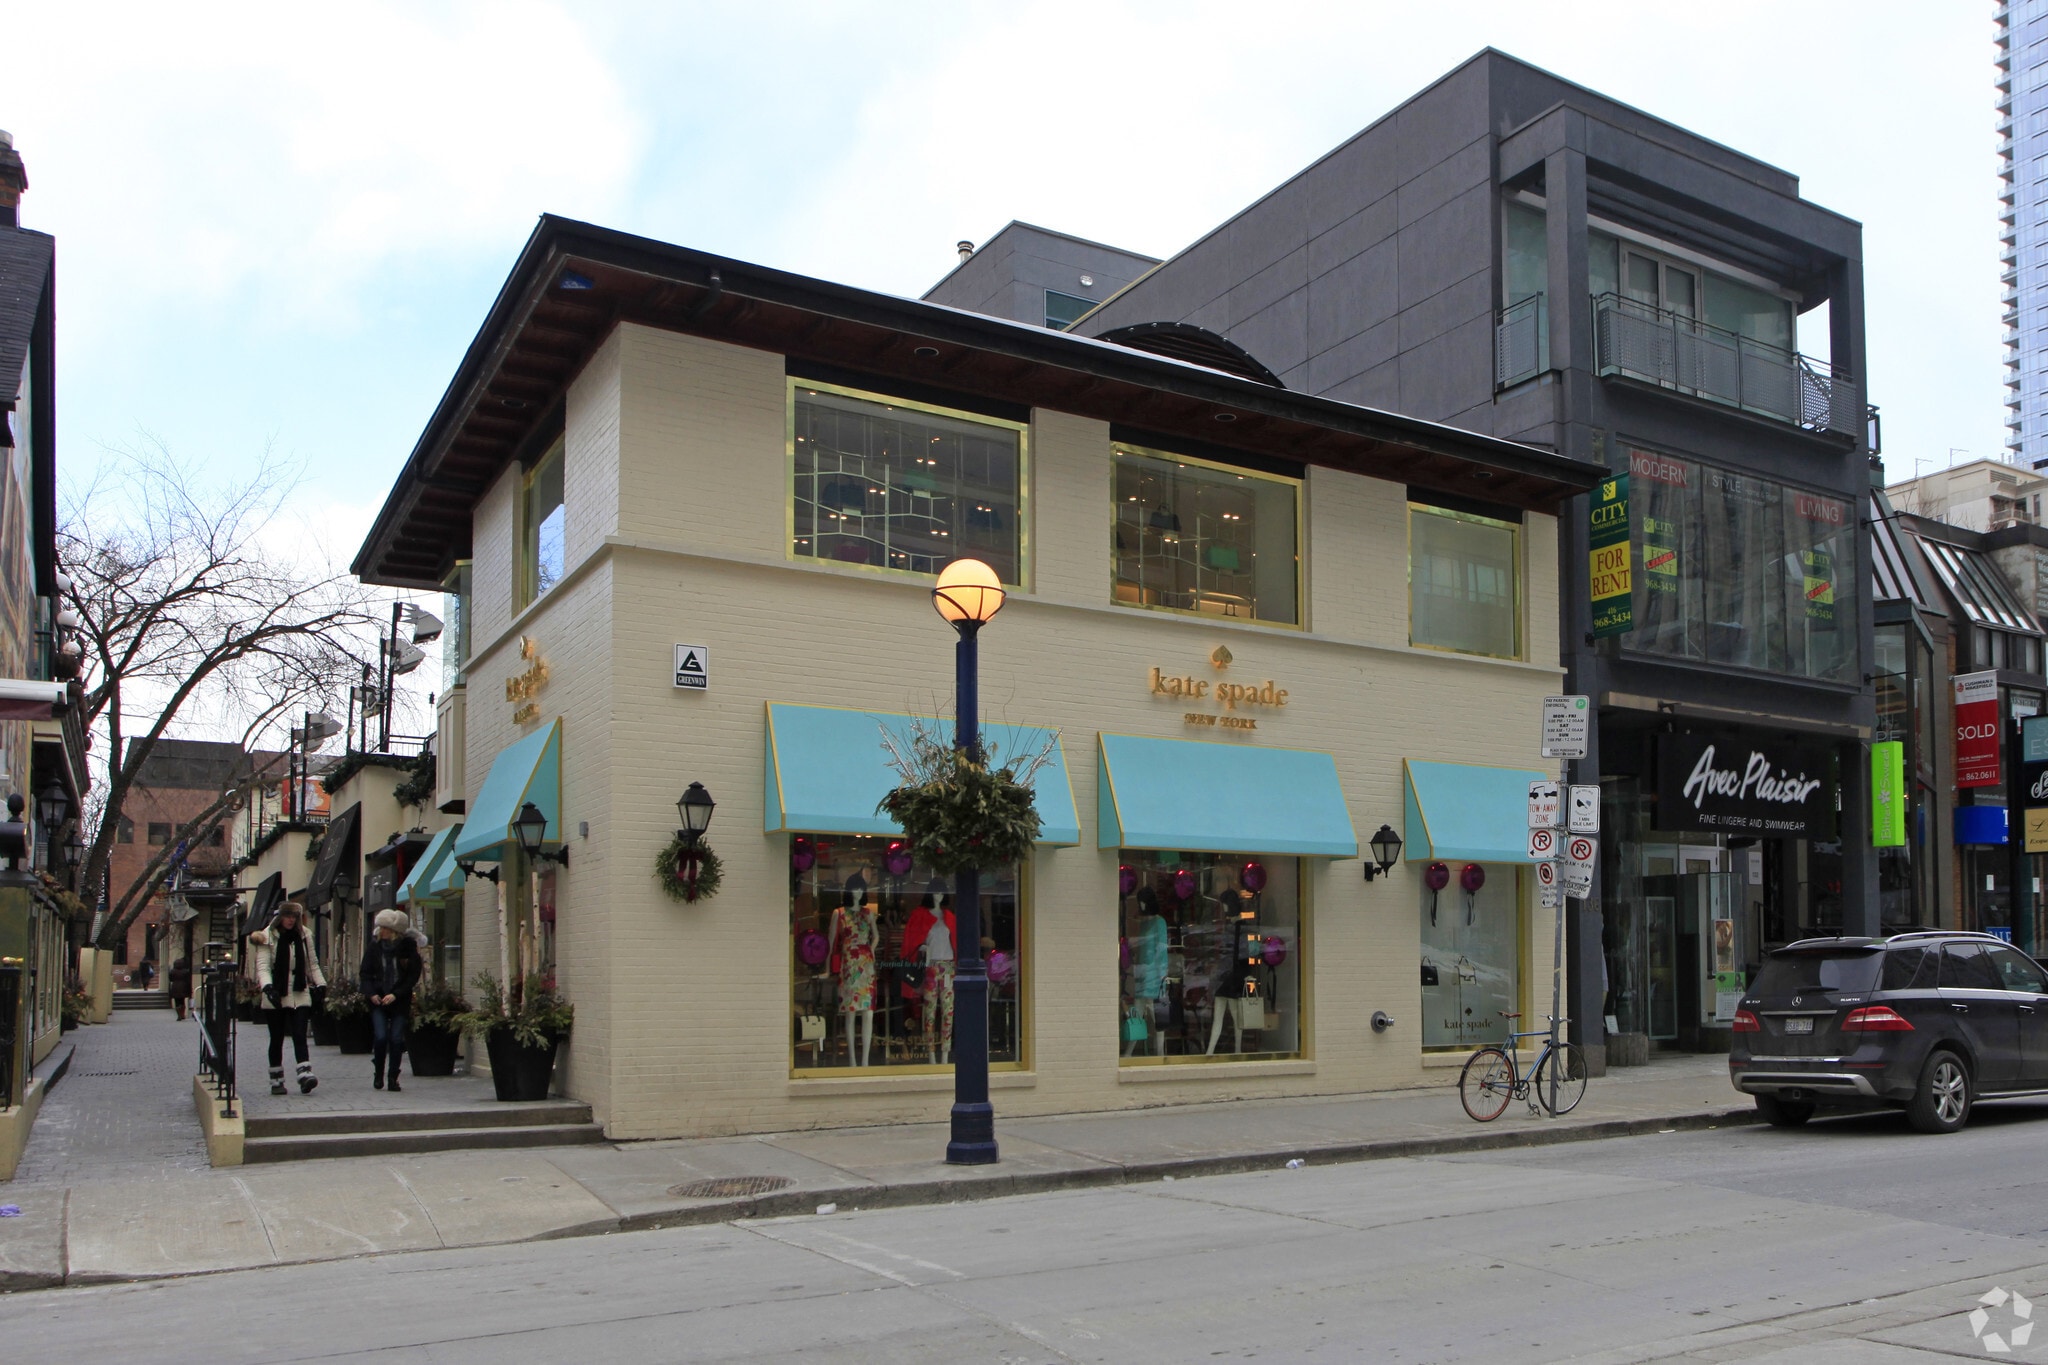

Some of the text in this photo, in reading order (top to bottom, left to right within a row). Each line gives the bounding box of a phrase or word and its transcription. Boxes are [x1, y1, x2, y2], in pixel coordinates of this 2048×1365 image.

[1630, 455, 1687, 484] MODERN
[1712, 475, 1742, 493] STYLE
[1591, 500, 1627, 524] CITY
[1800, 499, 1839, 522] LIVING
[1654, 520, 1675, 533] CITY
[1596, 548, 1623, 572] FOR
[1814, 554, 1831, 565] CITY
[1592, 570, 1629, 596] RENT
[1645, 578, 1677, 592] 968-3434
[1607, 605, 1617, 615] 416
[1593, 611, 1631, 629] 968-3434
[678, 675, 705, 686] GREENWIN
[1151, 667, 1289, 709] kate spade
[1184, 713, 1257, 729] NEW YORK
[1957, 723, 1995, 741] SOLD
[1683, 744, 1821, 809] Avec Plaisir
[1880, 749, 1890, 789] Sweet
[1966, 770, 1996, 780] 862.0611
[1535, 815, 1549, 823] ZONE
[1699, 814, 1805, 831] FINE LINGERIE AND SWIMWEAR
[1564, 882, 1587, 892] LOADING
[1567, 889, 1581, 897] ZONE
[1444, 1019, 1493, 1032] kate spade
